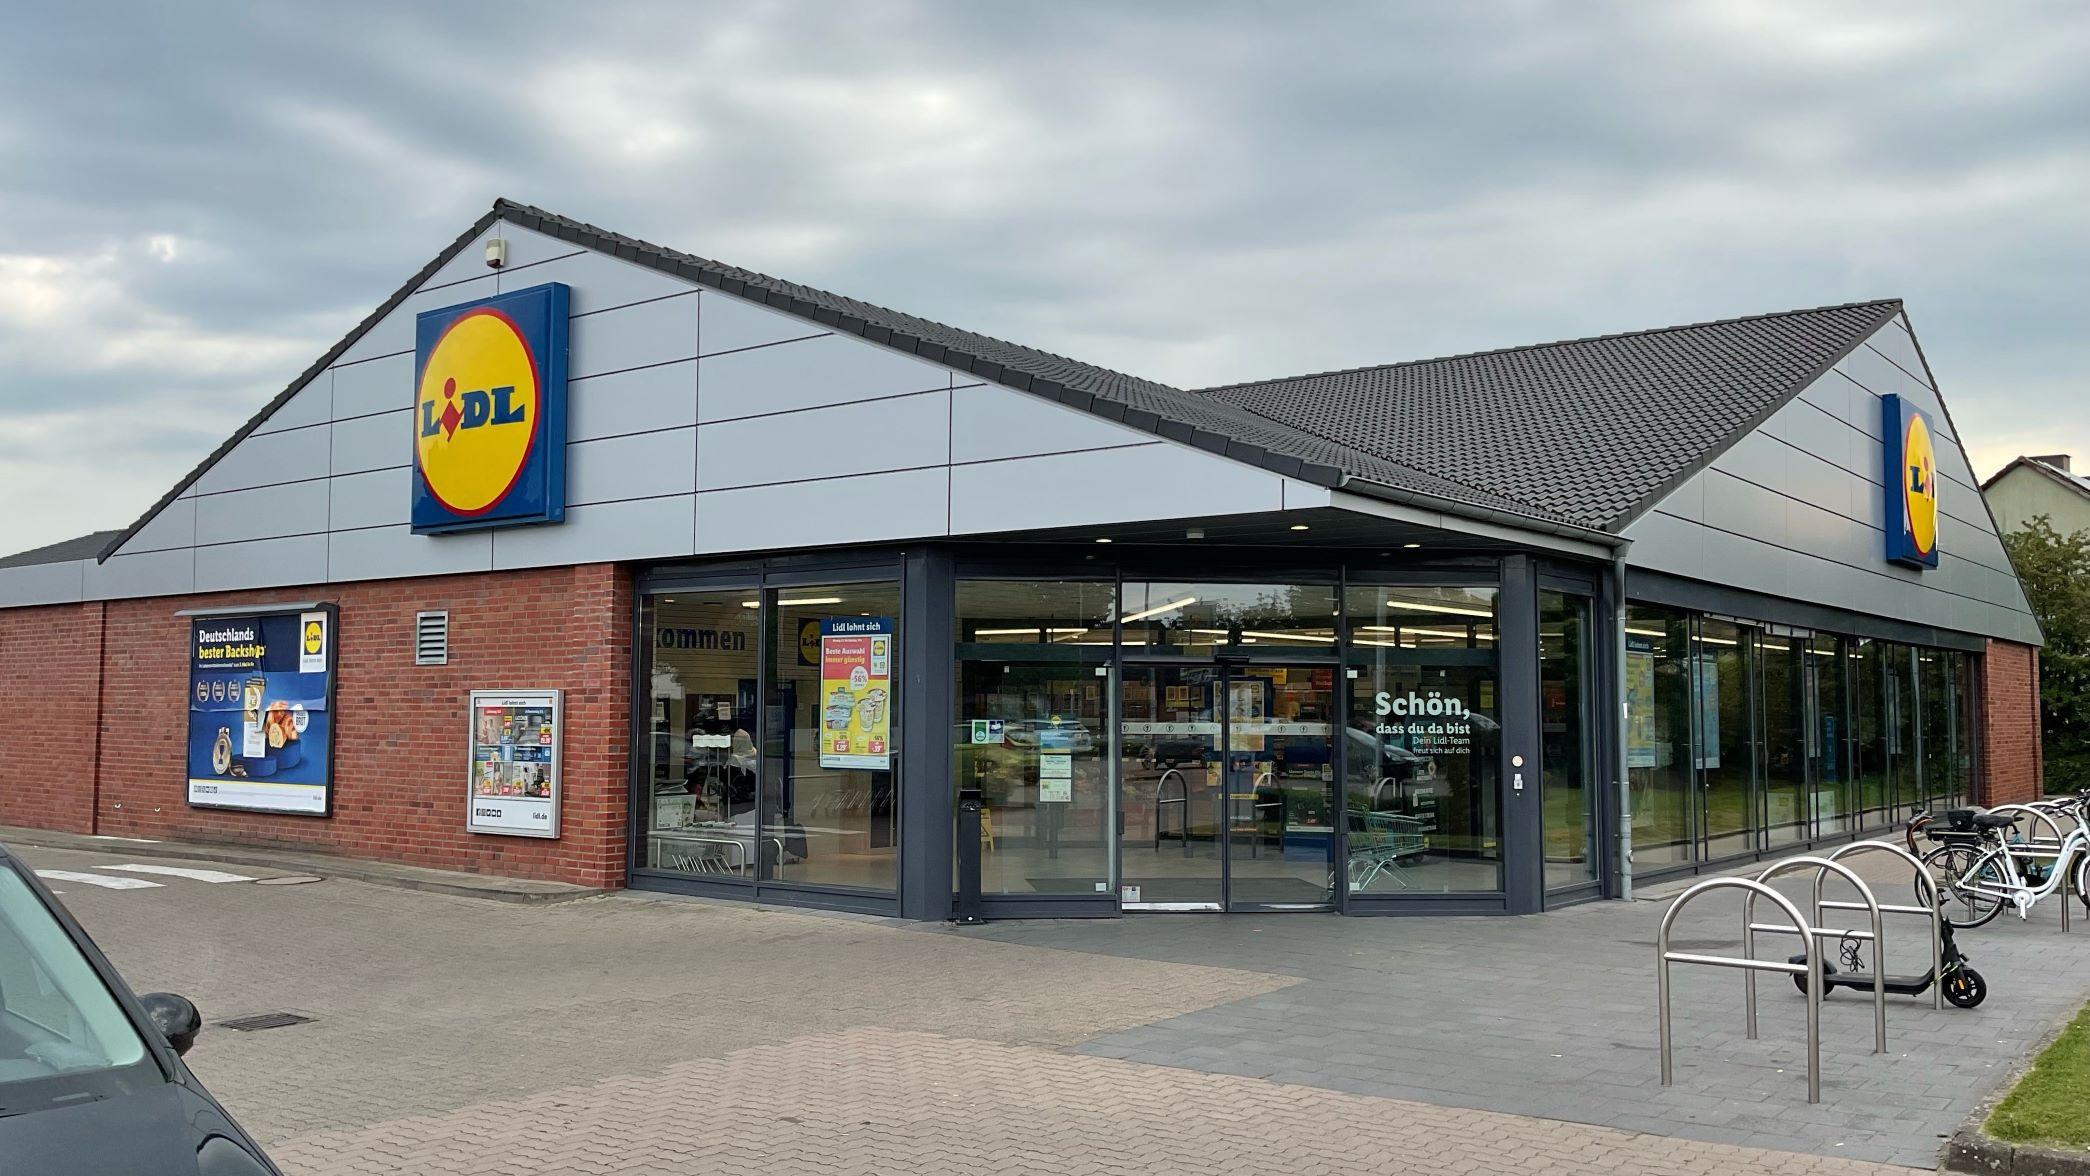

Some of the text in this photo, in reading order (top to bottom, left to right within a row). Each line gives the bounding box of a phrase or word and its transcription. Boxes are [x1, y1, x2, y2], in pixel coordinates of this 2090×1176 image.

[832, 621, 880, 631] Lidl lohnt sich
[199, 627, 254, 642] Deutschlands
[656, 627, 746, 651] ommen
[199, 646, 224, 658] bester
[1375, 691, 1471, 720] Schön,
[1375, 722, 1471, 734] dass du da bist
[1412, 736, 1470, 745] Dein Lidl-Team
